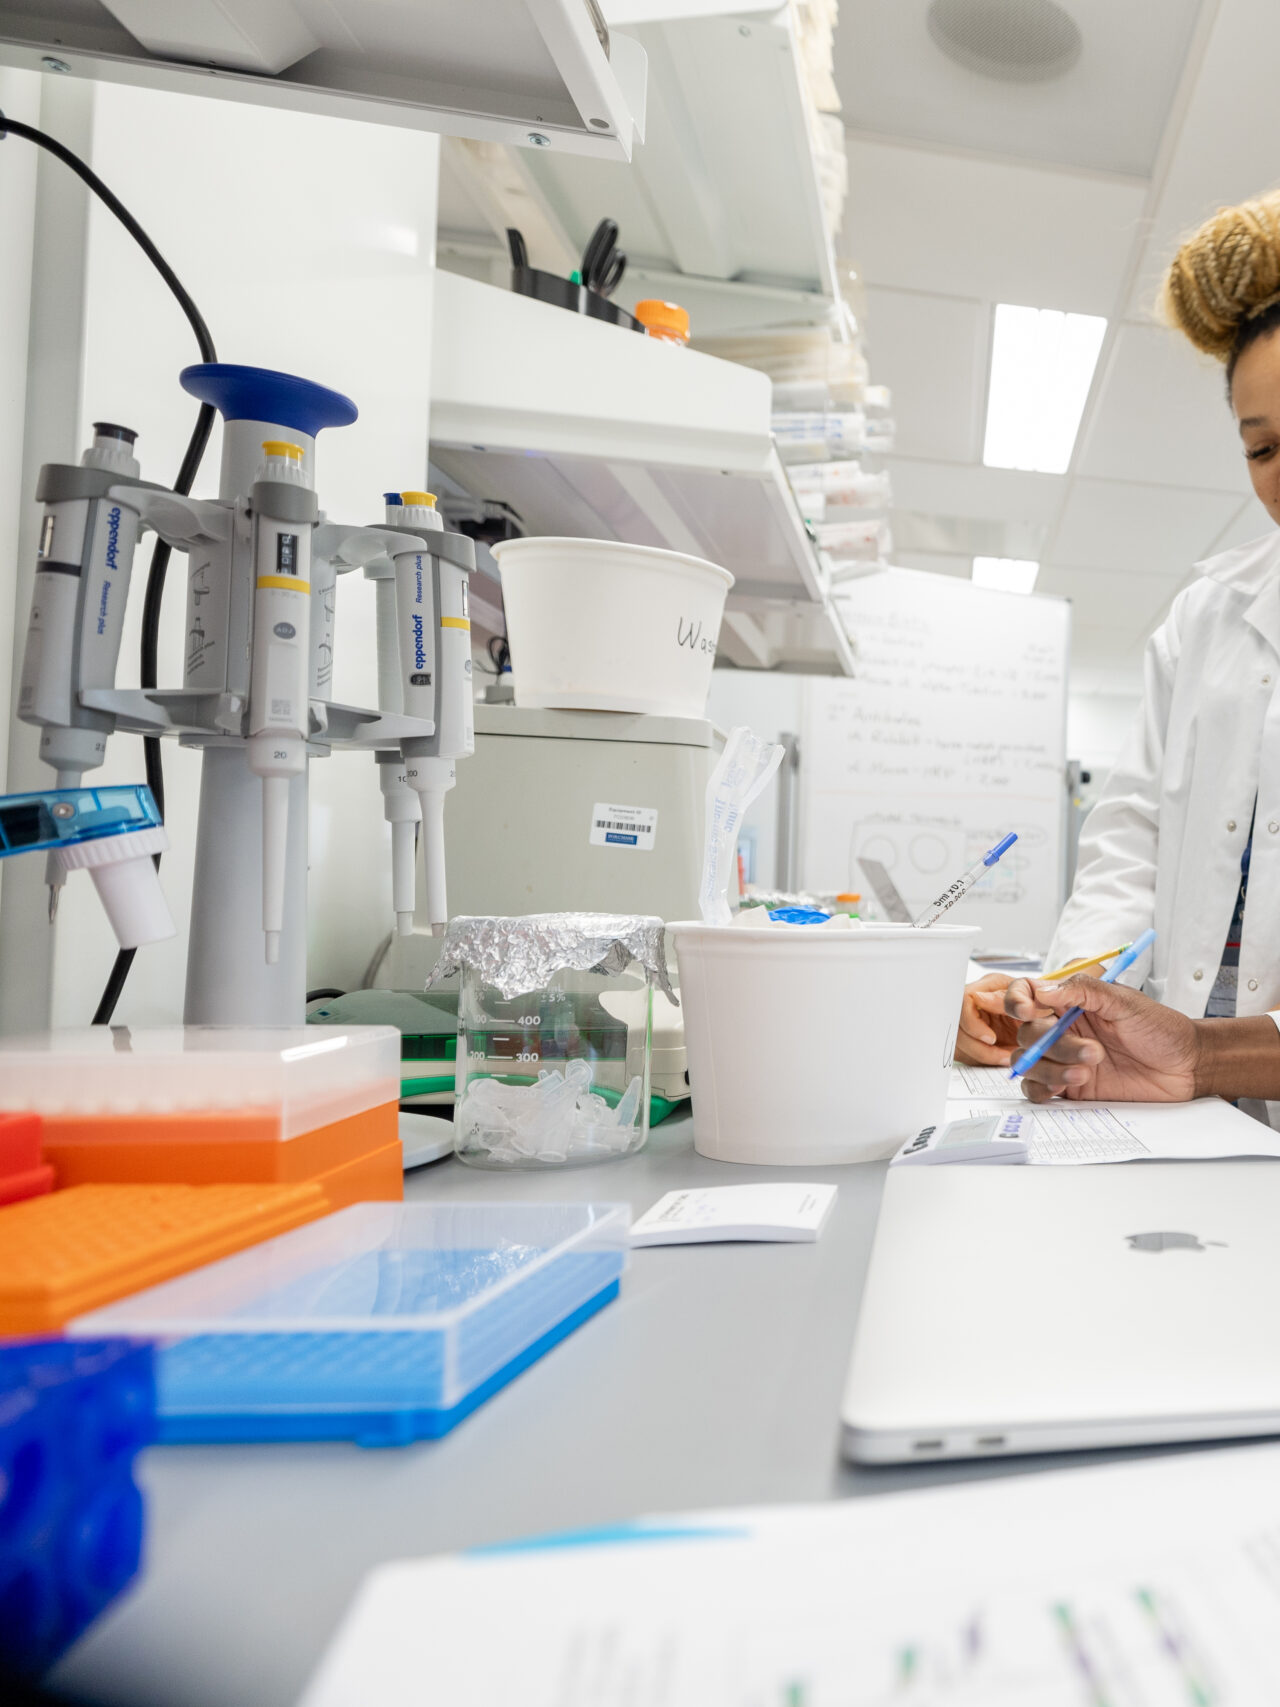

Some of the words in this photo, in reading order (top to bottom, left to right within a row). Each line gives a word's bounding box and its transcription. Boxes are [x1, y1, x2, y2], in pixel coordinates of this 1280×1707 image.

[106, 507, 121, 570] eppendorf
[412, 614, 426, 669] eppendorf
[274, 751, 287, 759] 20
[517, 1016, 540, 1025] 400
[516, 1052, 538, 1062] 300
